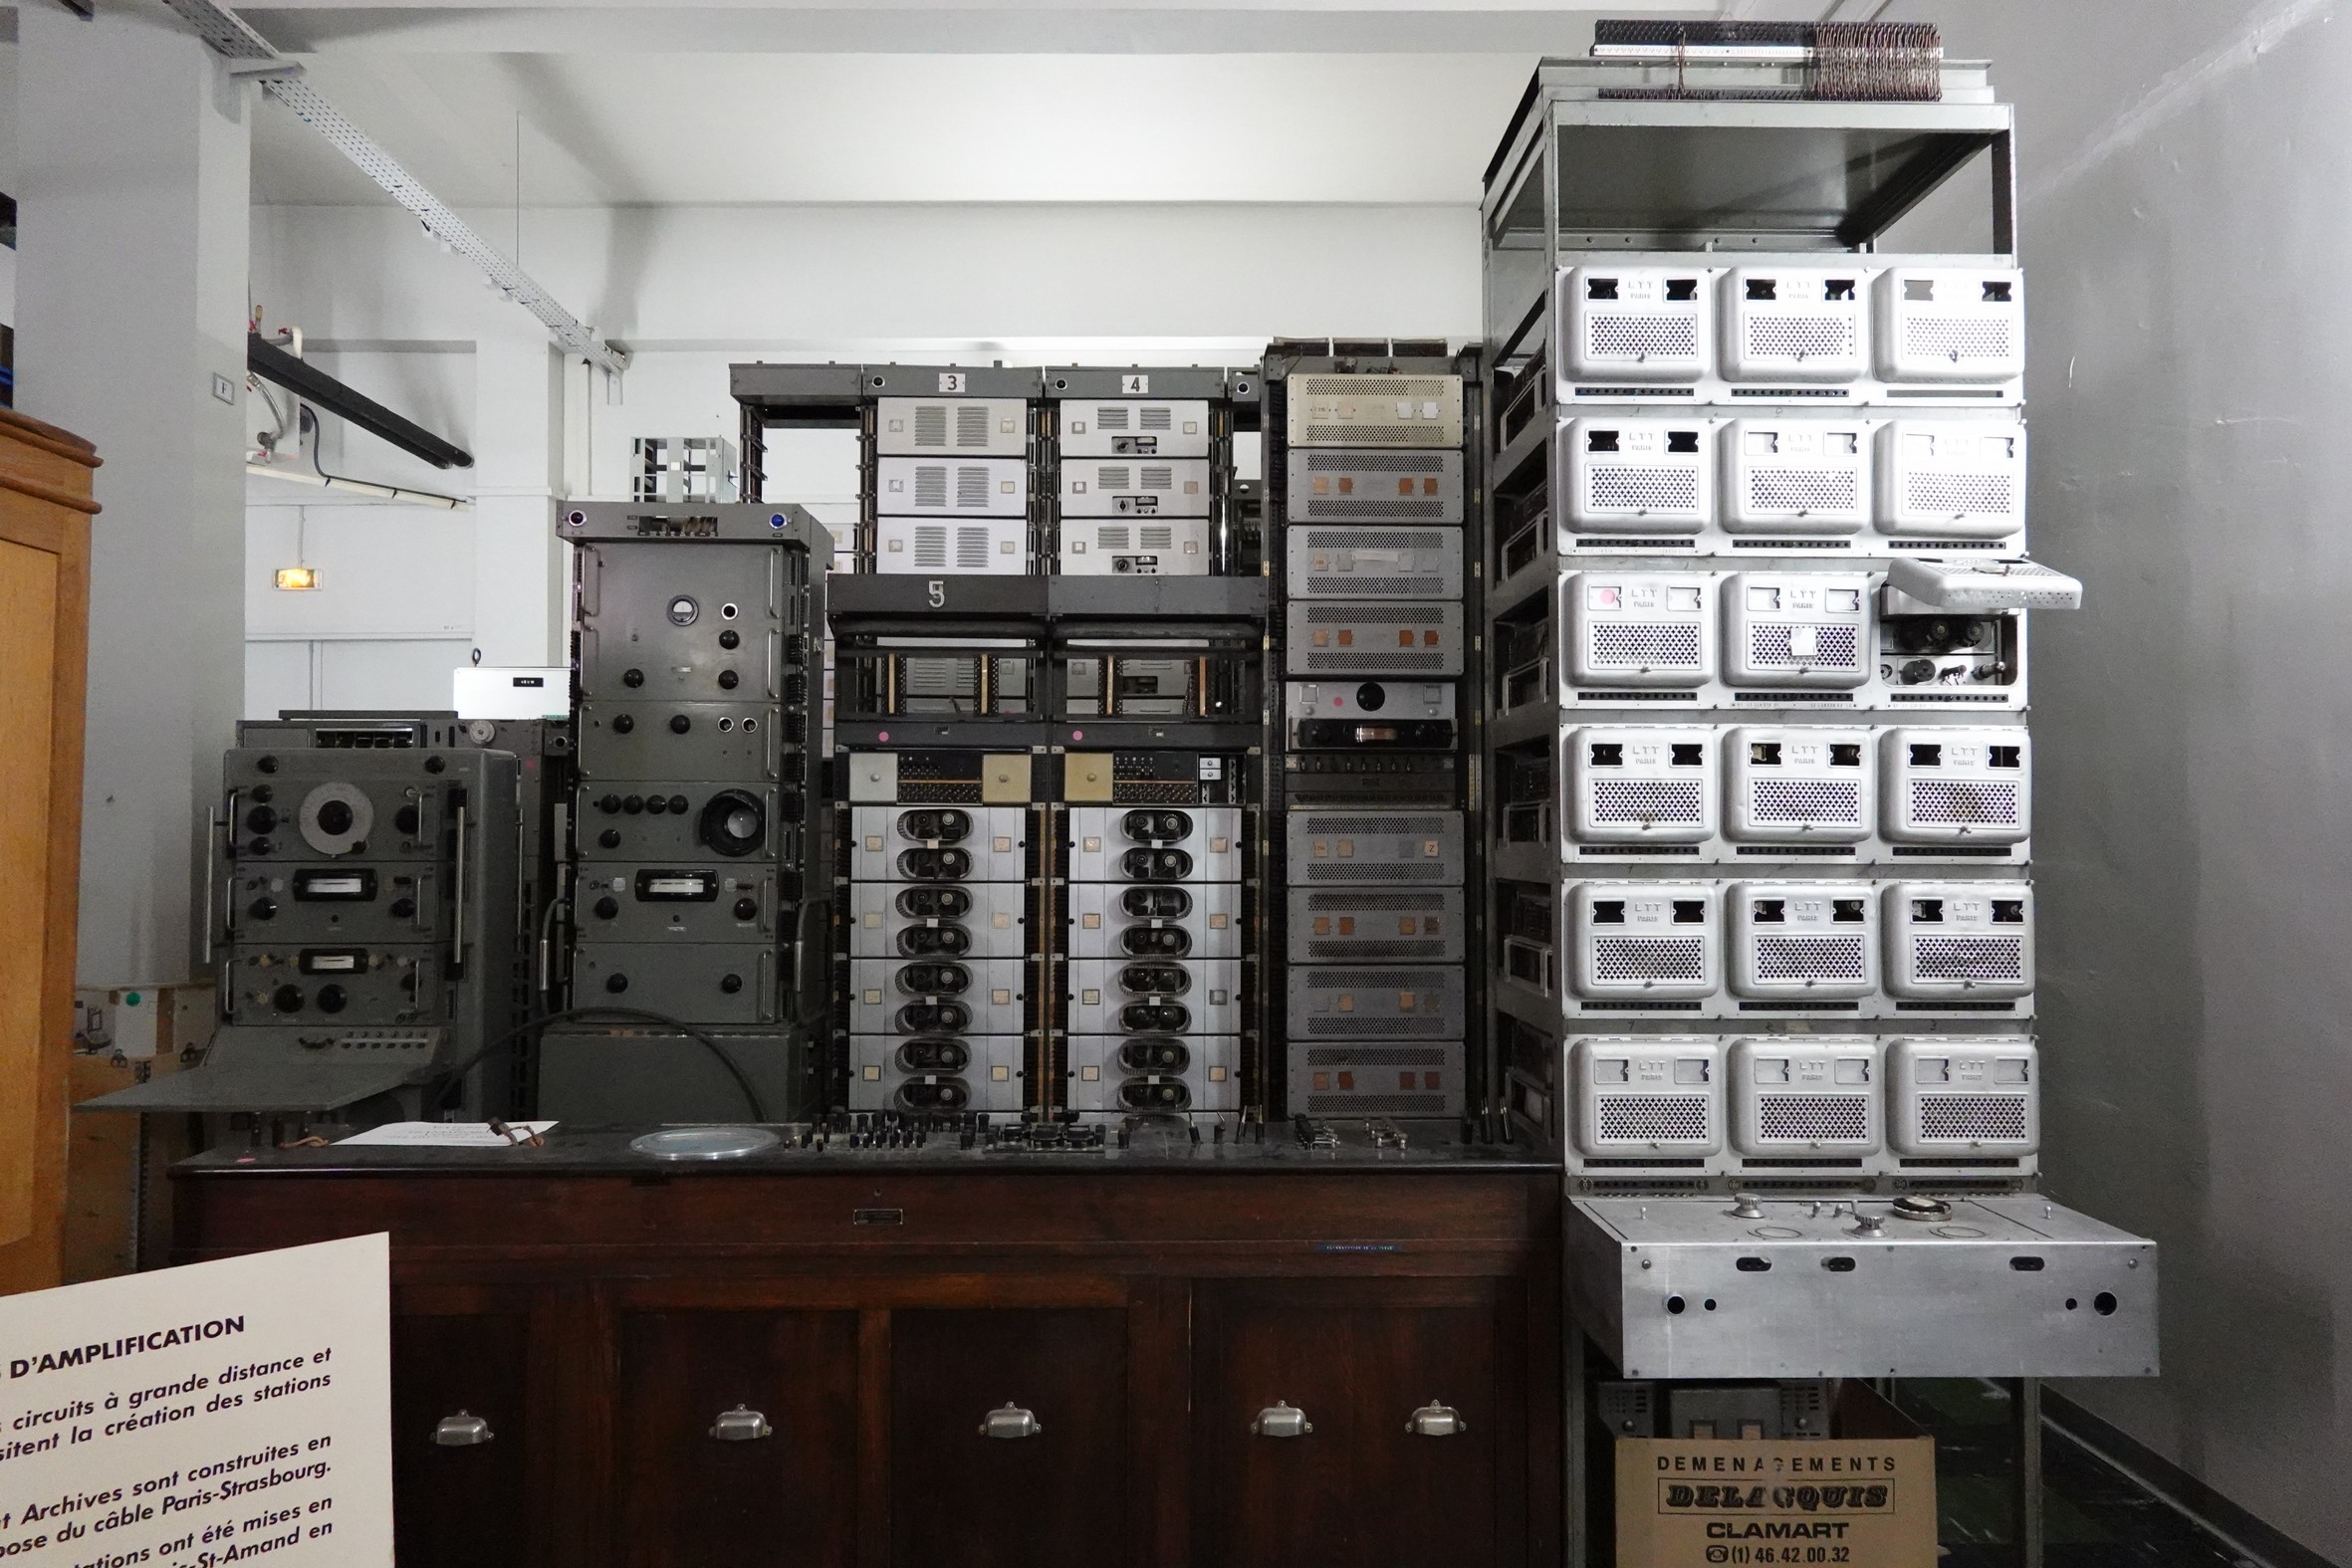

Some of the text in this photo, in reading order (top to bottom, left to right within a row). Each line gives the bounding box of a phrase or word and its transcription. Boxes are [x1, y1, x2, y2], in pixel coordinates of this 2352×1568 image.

[947, 374, 958, 390] 3
[1130, 376, 1141, 392] 4
[928, 580, 945, 608] 5
[1631, 588, 1658, 597] LTT
[1790, 589, 1816, 599] LTT
[1632, 746, 1659, 755] LTT
[1791, 745, 1818, 755] LTT
[1952, 747, 1978, 756] LTT
[1635, 903, 1662, 912] LTT
[1794, 902, 1821, 911] LTT
[1953, 902, 1980, 911] LTT
[1639, 1060, 1666, 1070] LTT
[1799, 1060, 1826, 1070] LTT
[1960, 1060, 1986, 1070] LTT
[10, 1315, 245, 1379] D'AMPLIFICATION
[13, 1347, 332, 1431] circuits à grande distance et
[71, 1426, 93, 1444] la
[105, 1405, 195, 1436] création
[206, 1393, 243, 1413] des
[253, 1375, 331, 1402] stations
[21, 1487, 122, 1525] Archives
[131, 1470, 179, 1496] sont
[187, 1446, 299, 1481] construites
[308, 1436, 332, 1452] en
[56, 1521, 86, 1543] du
[94, 1503, 153, 1533] câble
[161, 1461, 332, 1515] Paris-Strasbourg.
[159, 1533, 194, 1555] ont
[201, 1519, 235, 1543] été
[243, 1506, 301, 1533] mises
[309, 1497, 333, 1513] en
[309, 1523, 333, 1539] en
[1707, 1522, 1850, 1539] CLAMART
[1732, 1547, 1850, 1564] (1) 46.42.00.32
